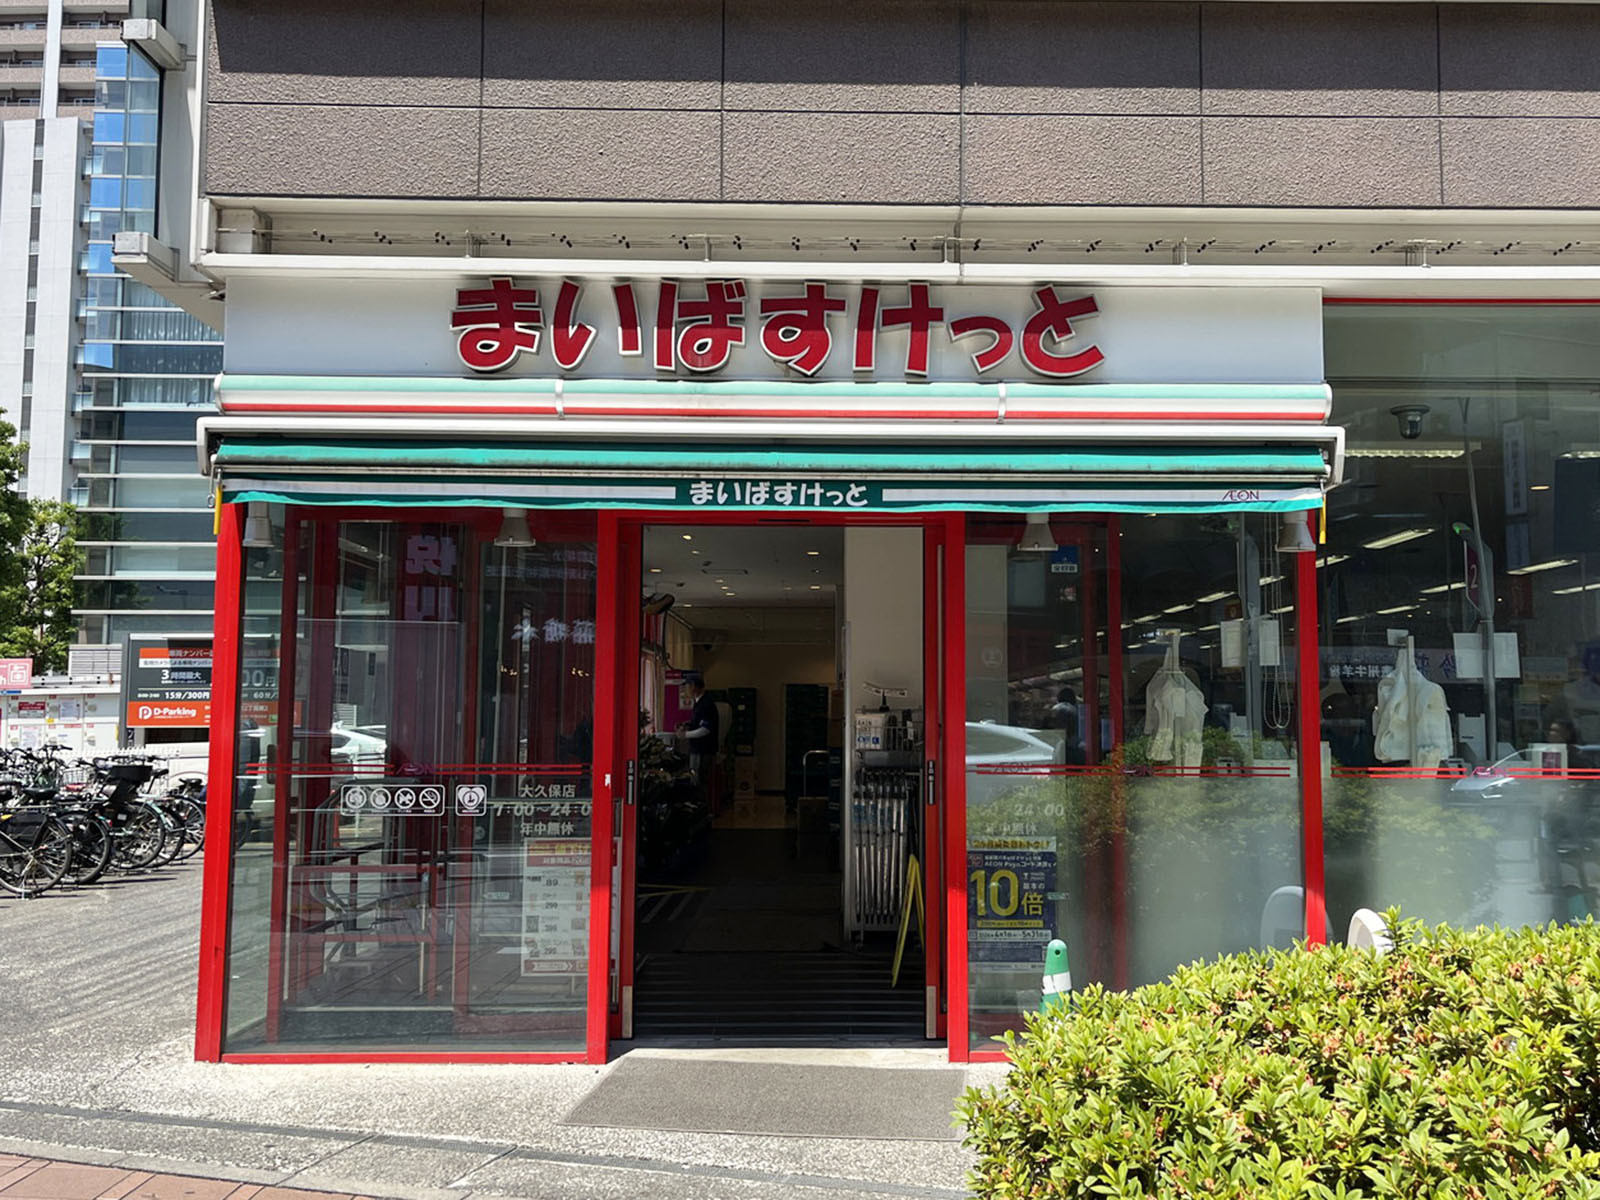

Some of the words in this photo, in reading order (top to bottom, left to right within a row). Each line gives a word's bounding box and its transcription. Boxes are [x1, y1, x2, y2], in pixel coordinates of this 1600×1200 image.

[451, 276, 1105, 378] まいばすけっと
[689, 480, 869, 507] まいばすけっと
[242, 669, 276, 687] 00円
[153, 707, 197, 717] D-Parking
[520, 784, 577, 799] 大久保店
[520, 821, 575, 836] 年中無休
